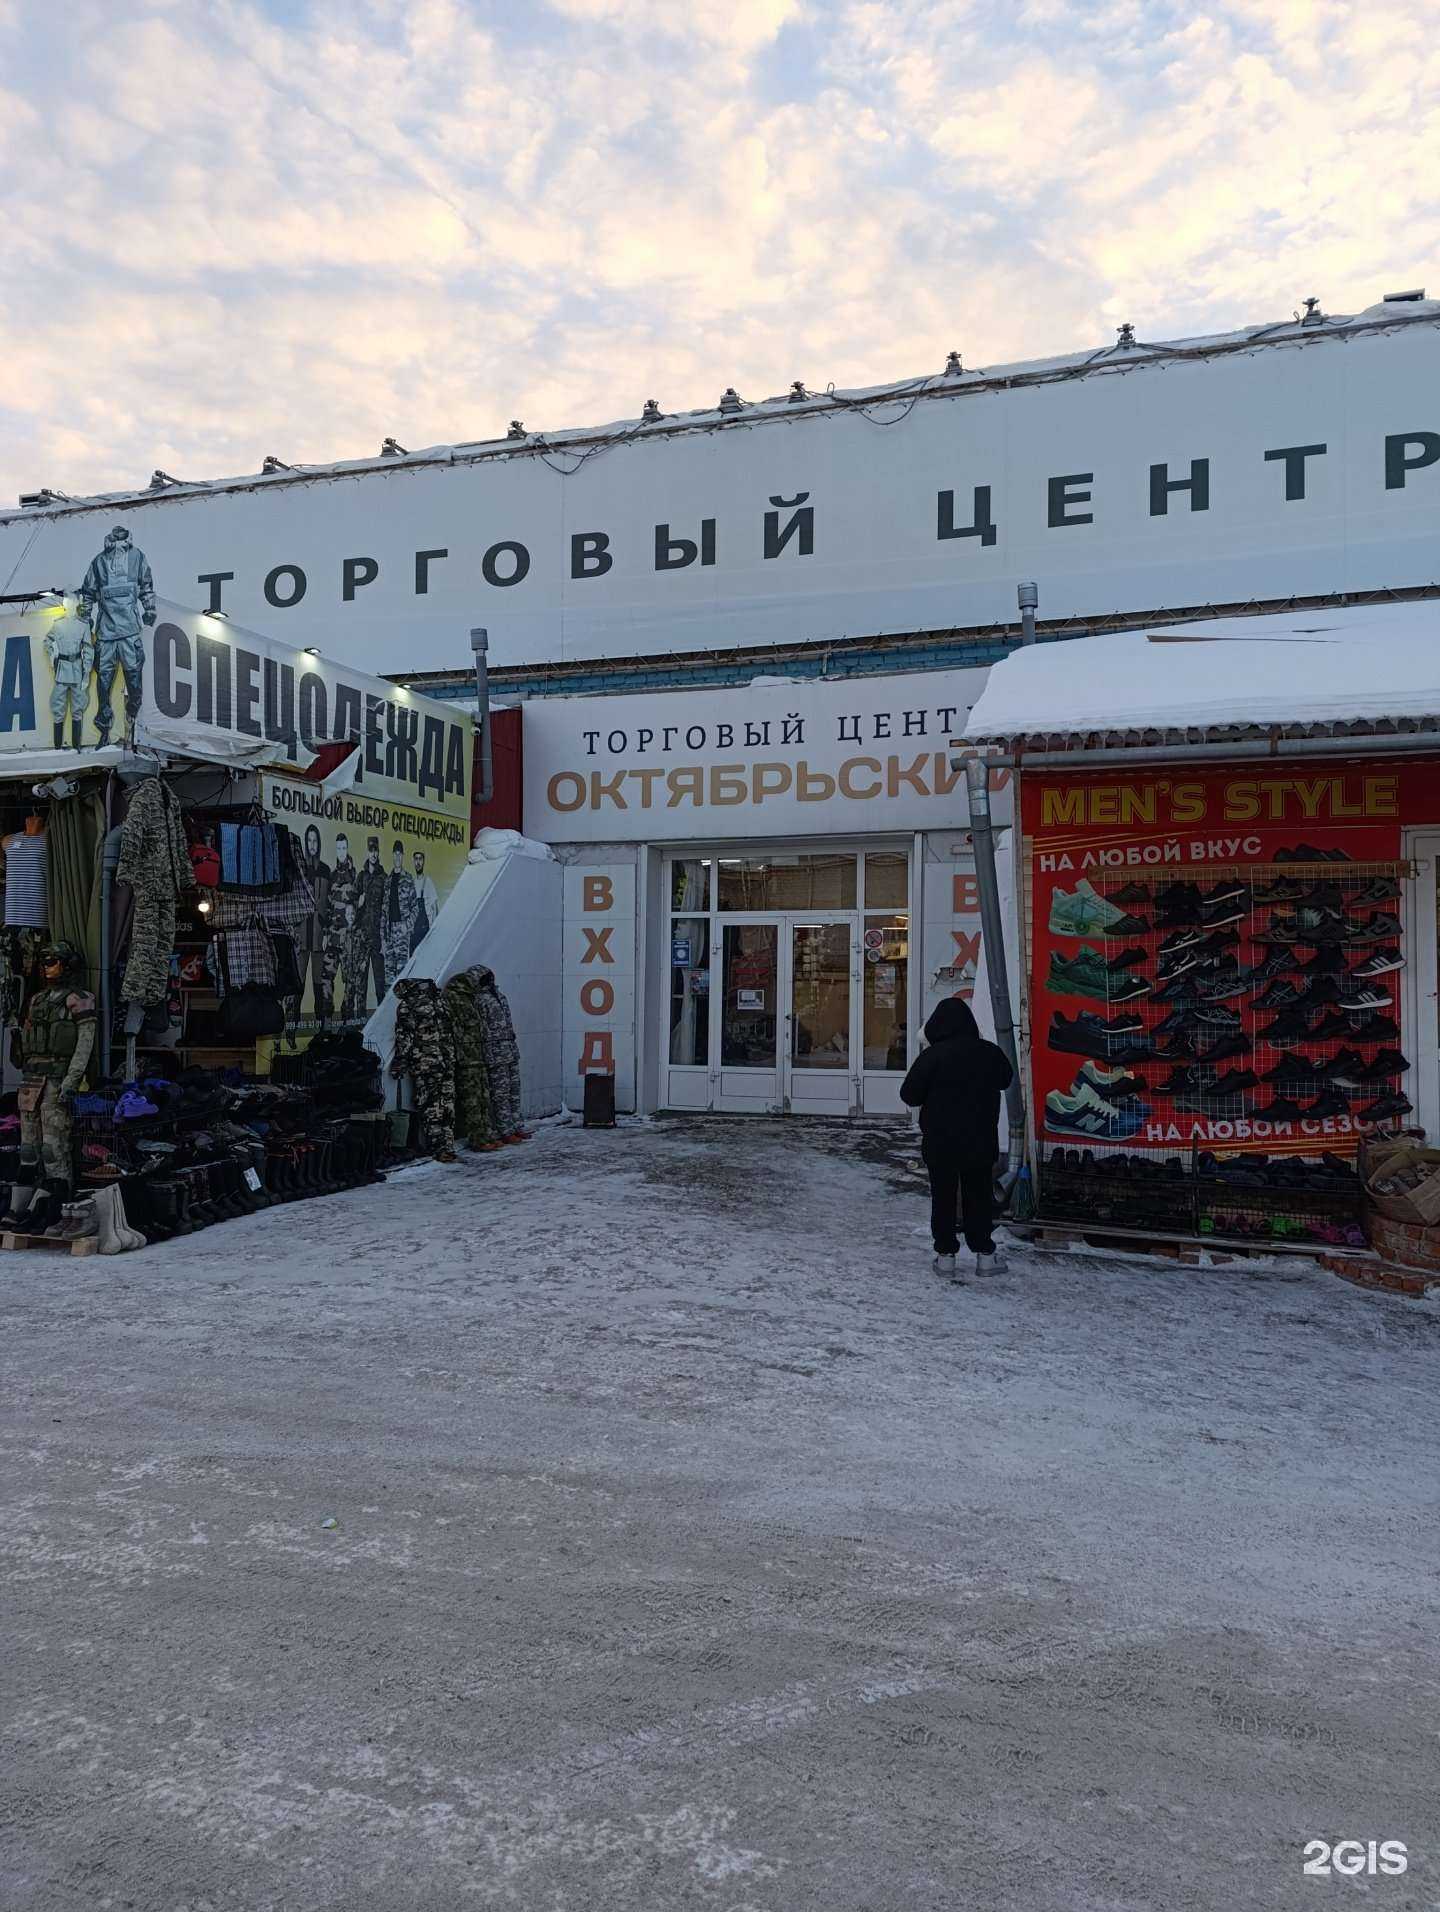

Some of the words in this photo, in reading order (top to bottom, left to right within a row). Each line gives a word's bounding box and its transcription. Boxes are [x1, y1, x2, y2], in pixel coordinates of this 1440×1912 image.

[198, 492, 814, 612] ТОРГОВЫЙ
[937, 431, 1440, 547] ЦЕНТР
[153, 622, 466, 803] СПЕЦОДЕЖДА
[583, 713, 806, 755] ТОРГОВЫЙ
[837, 705, 975, 746] ЦЕНТ
[272, 785, 344, 822] БОЛЬШОЙ
[346, 801, 390, 829] ВЫБОР
[391, 811, 465, 846] СПЕЦОДЕЖДЫ
[1040, 780, 1208, 827] MEN'S
[1222, 774, 1401, 822] STYLE
[1040, 853, 1075, 873] НА
[1081, 839, 1182, 869] ЛЮБОЙ
[1191, 836, 1263, 860] ВКУС
[578, 875, 616, 1076] ВХОД
[1147, 1123, 1184, 1142] НА
[1300, 1112, 1384, 1134] СЕЗО
